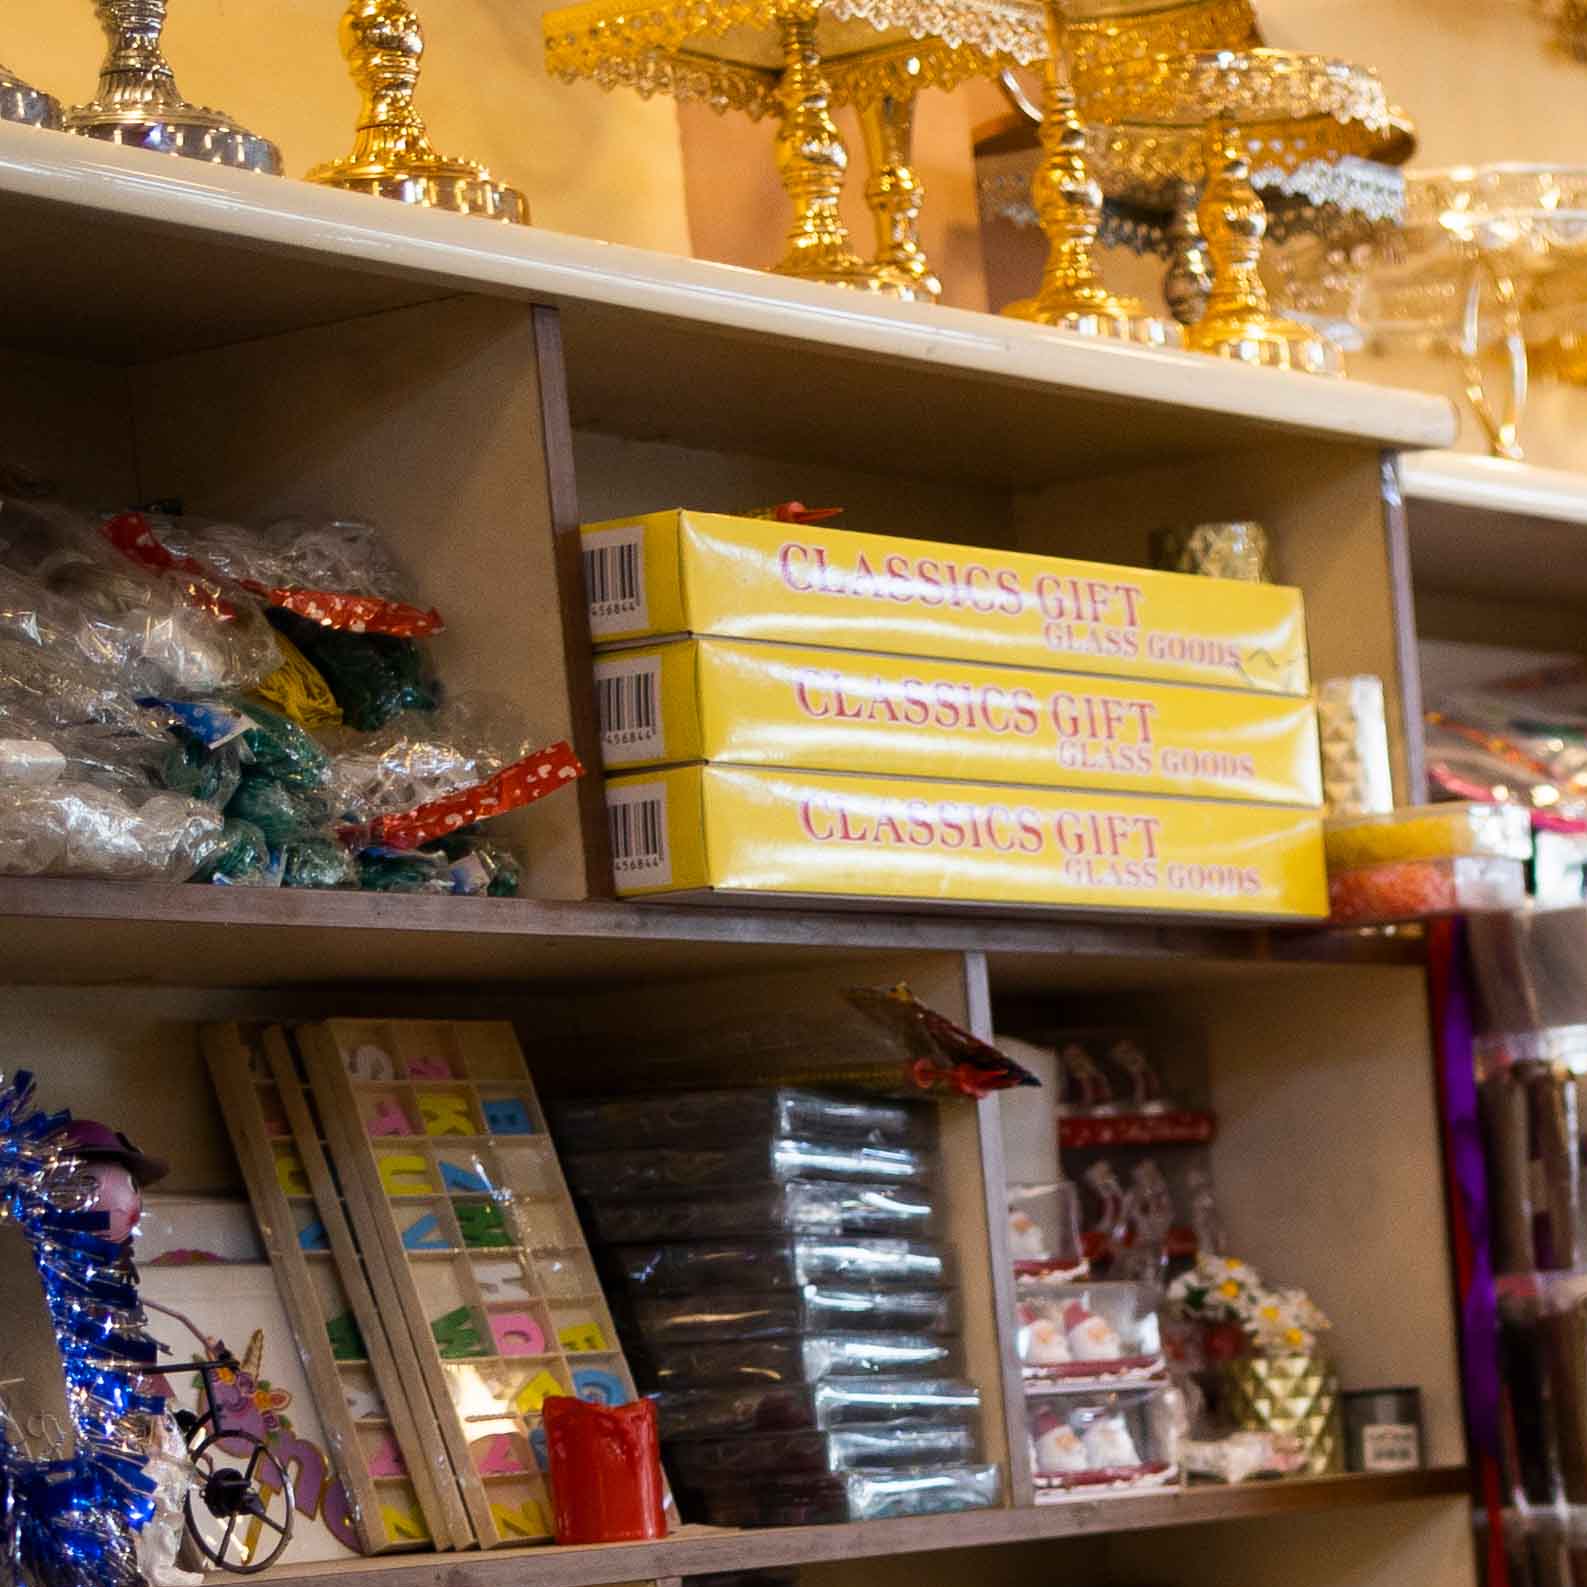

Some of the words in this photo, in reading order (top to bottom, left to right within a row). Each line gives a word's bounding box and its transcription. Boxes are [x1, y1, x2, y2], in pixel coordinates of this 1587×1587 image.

[777, 543, 1024, 615] CLASSICS
[1037, 576, 1142, 627] GIFT
[1043, 622, 1139, 658] GLASS
[1147, 631, 1241, 668] GOODS
[795, 670, 1039, 735] CLASSICS
[1052, 694, 1156, 743] GIFT
[1058, 740, 1152, 774] GLASS
[1161, 747, 1255, 778] GOODS
[800, 788, 1044, 853] CLASSICS
[1056, 811, 1161, 859] GIFT
[1063, 855, 1158, 889] GLASS
[1168, 863, 1261, 894] GOODS
